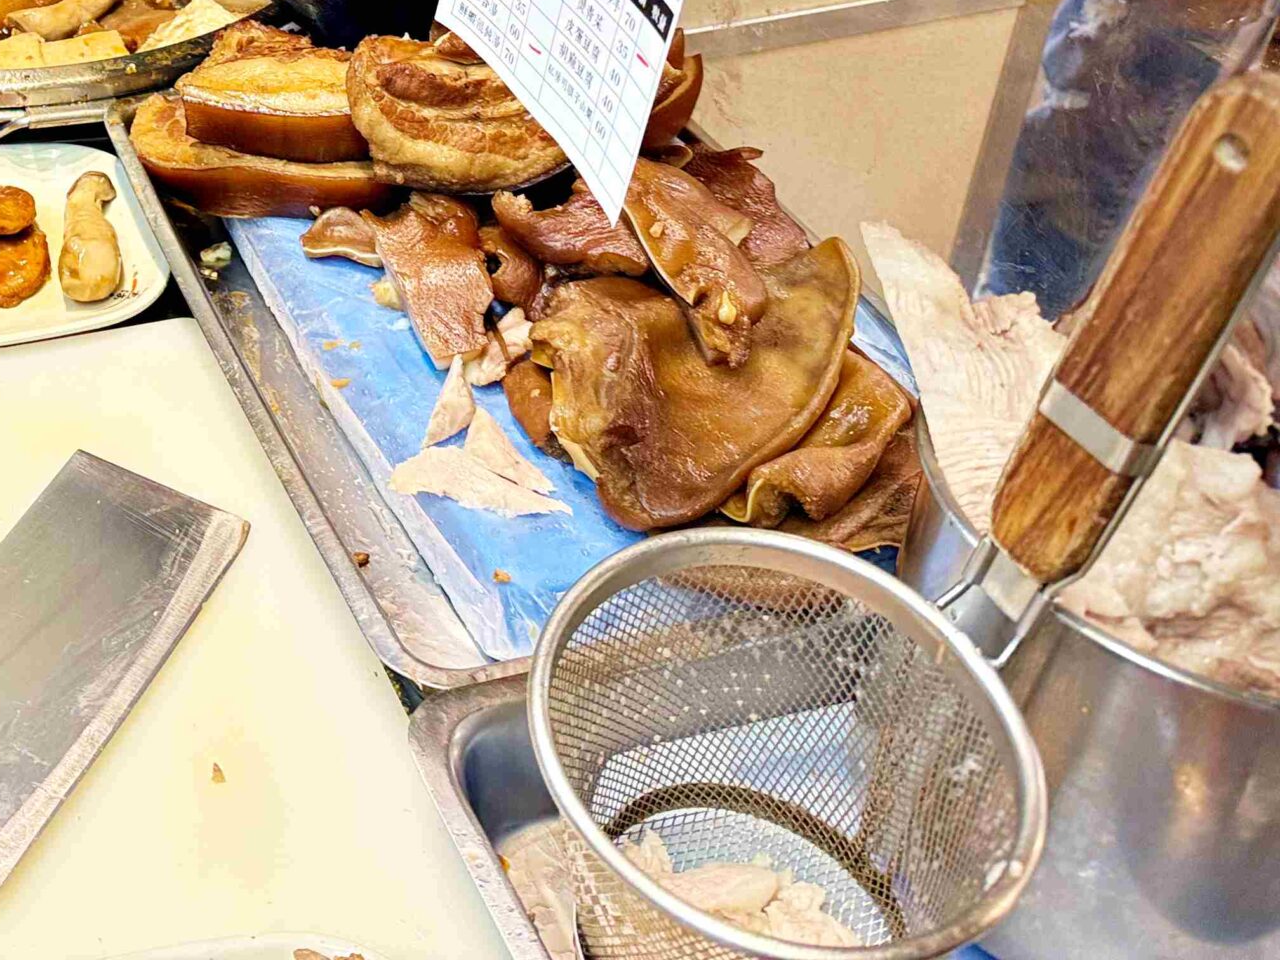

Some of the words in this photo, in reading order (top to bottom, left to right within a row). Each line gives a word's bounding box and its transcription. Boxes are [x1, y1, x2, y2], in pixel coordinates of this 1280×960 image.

[625, 12, 635, 32] 70
[510, 24, 520, 40] 60
[504, 48, 514, 64] 70
[616, 40, 628, 59] 35
[611, 69, 620, 86] 40
[602, 95, 613, 113] 40
[595, 120, 606, 140] 60
